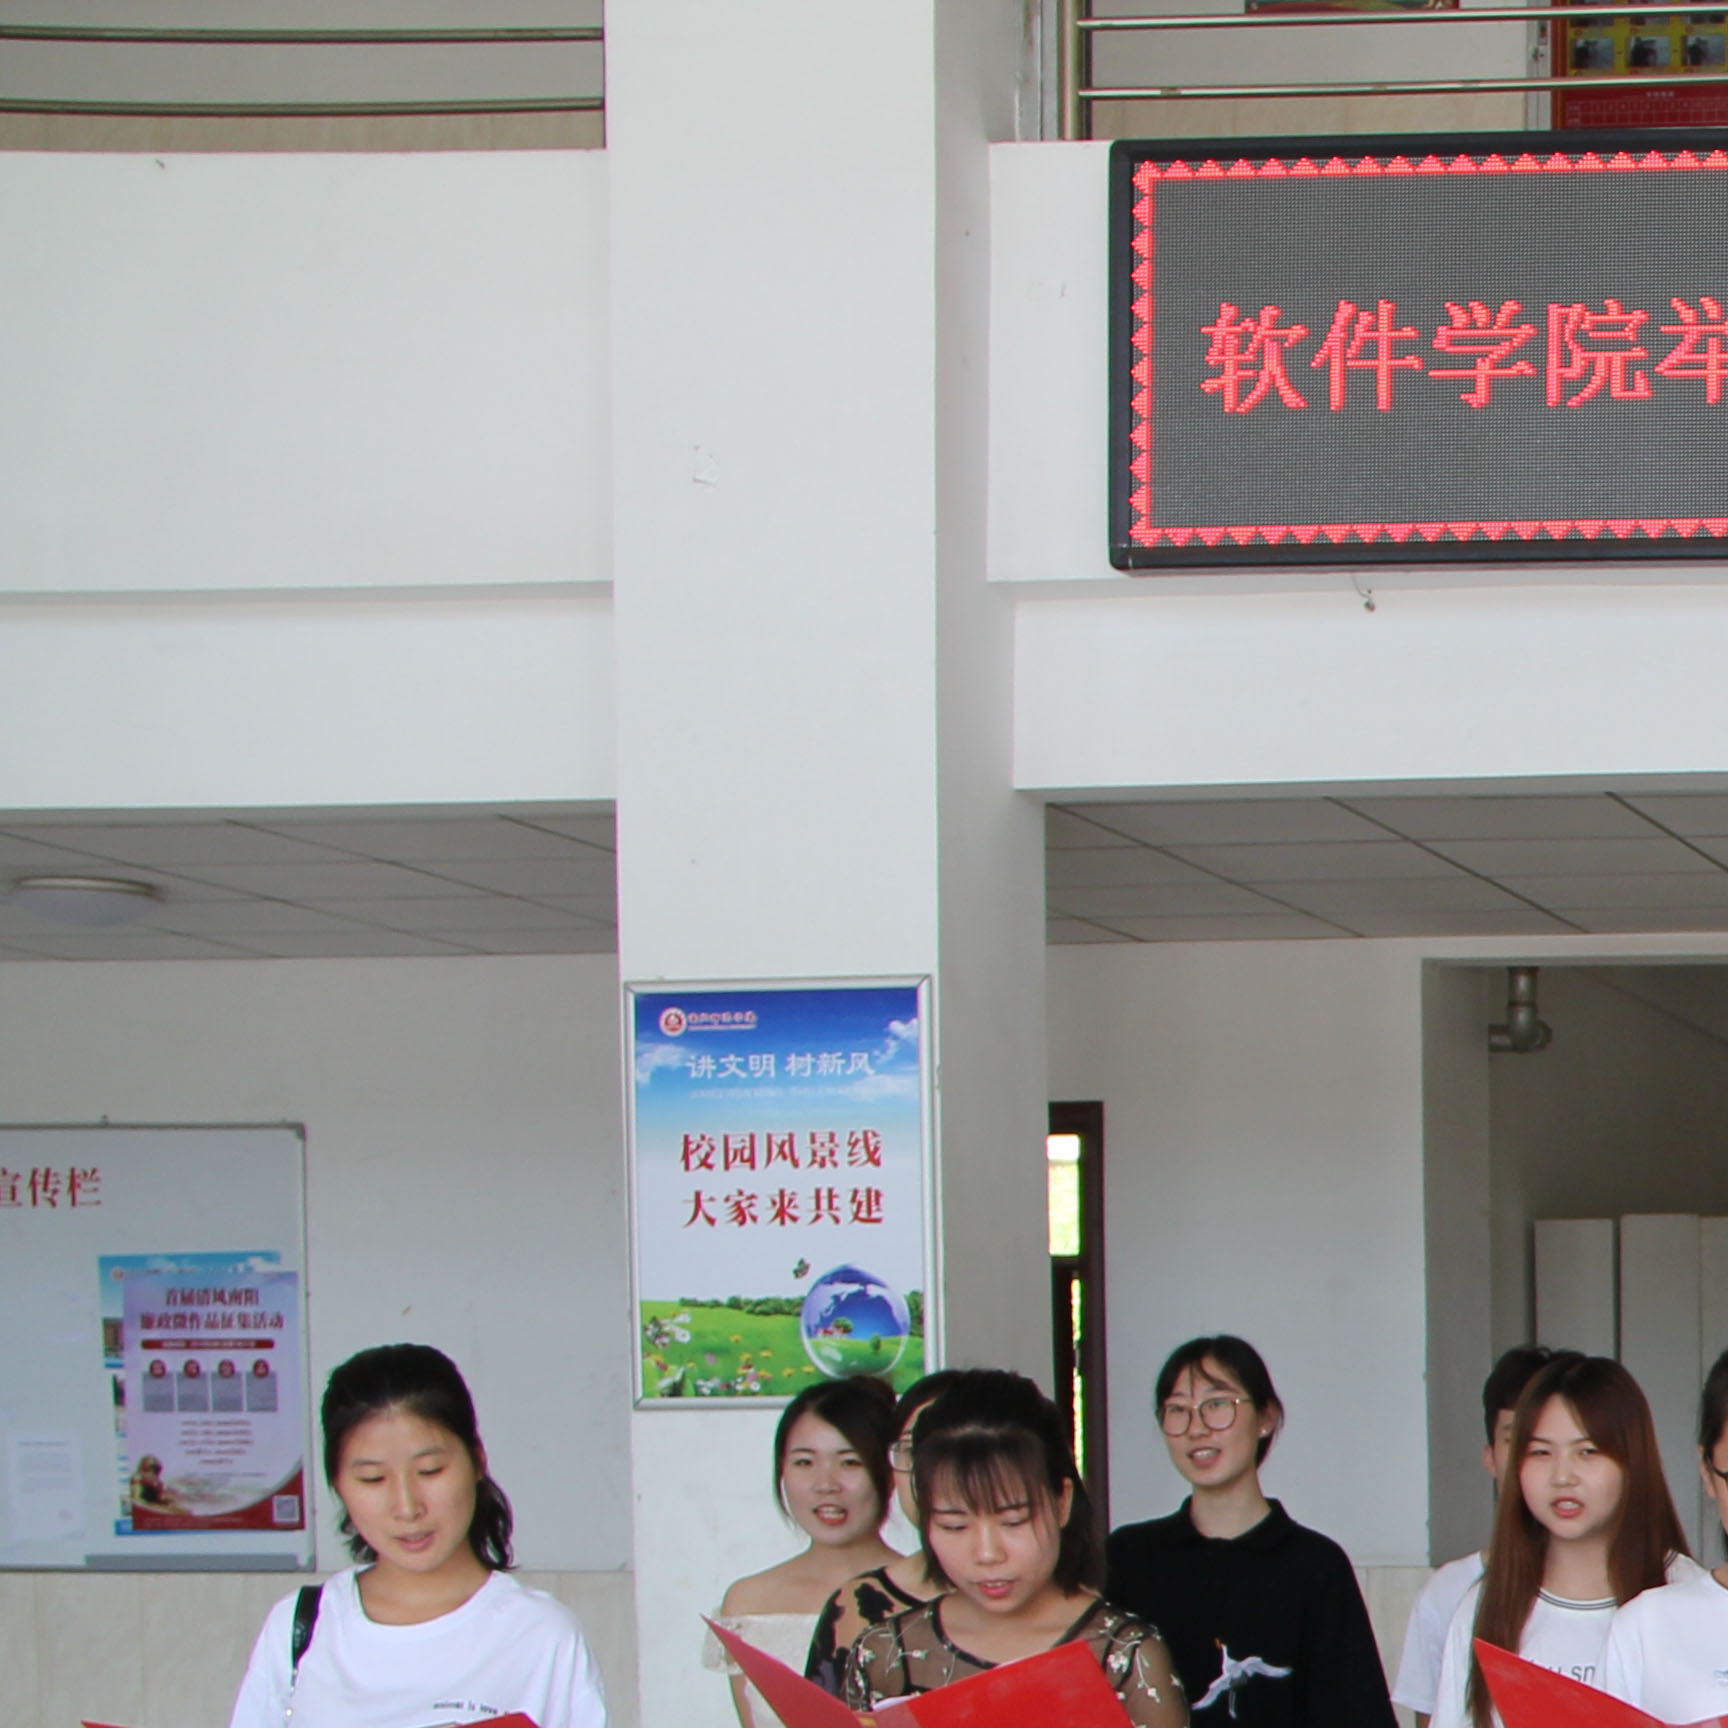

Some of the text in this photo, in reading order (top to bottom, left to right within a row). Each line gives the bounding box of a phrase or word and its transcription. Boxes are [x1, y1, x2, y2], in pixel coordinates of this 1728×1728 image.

[685, 1054, 777, 1079] 讲文明
[681, 1130, 882, 1172] 校园风景线
[683, 1187, 883, 1228] 大家来共建
